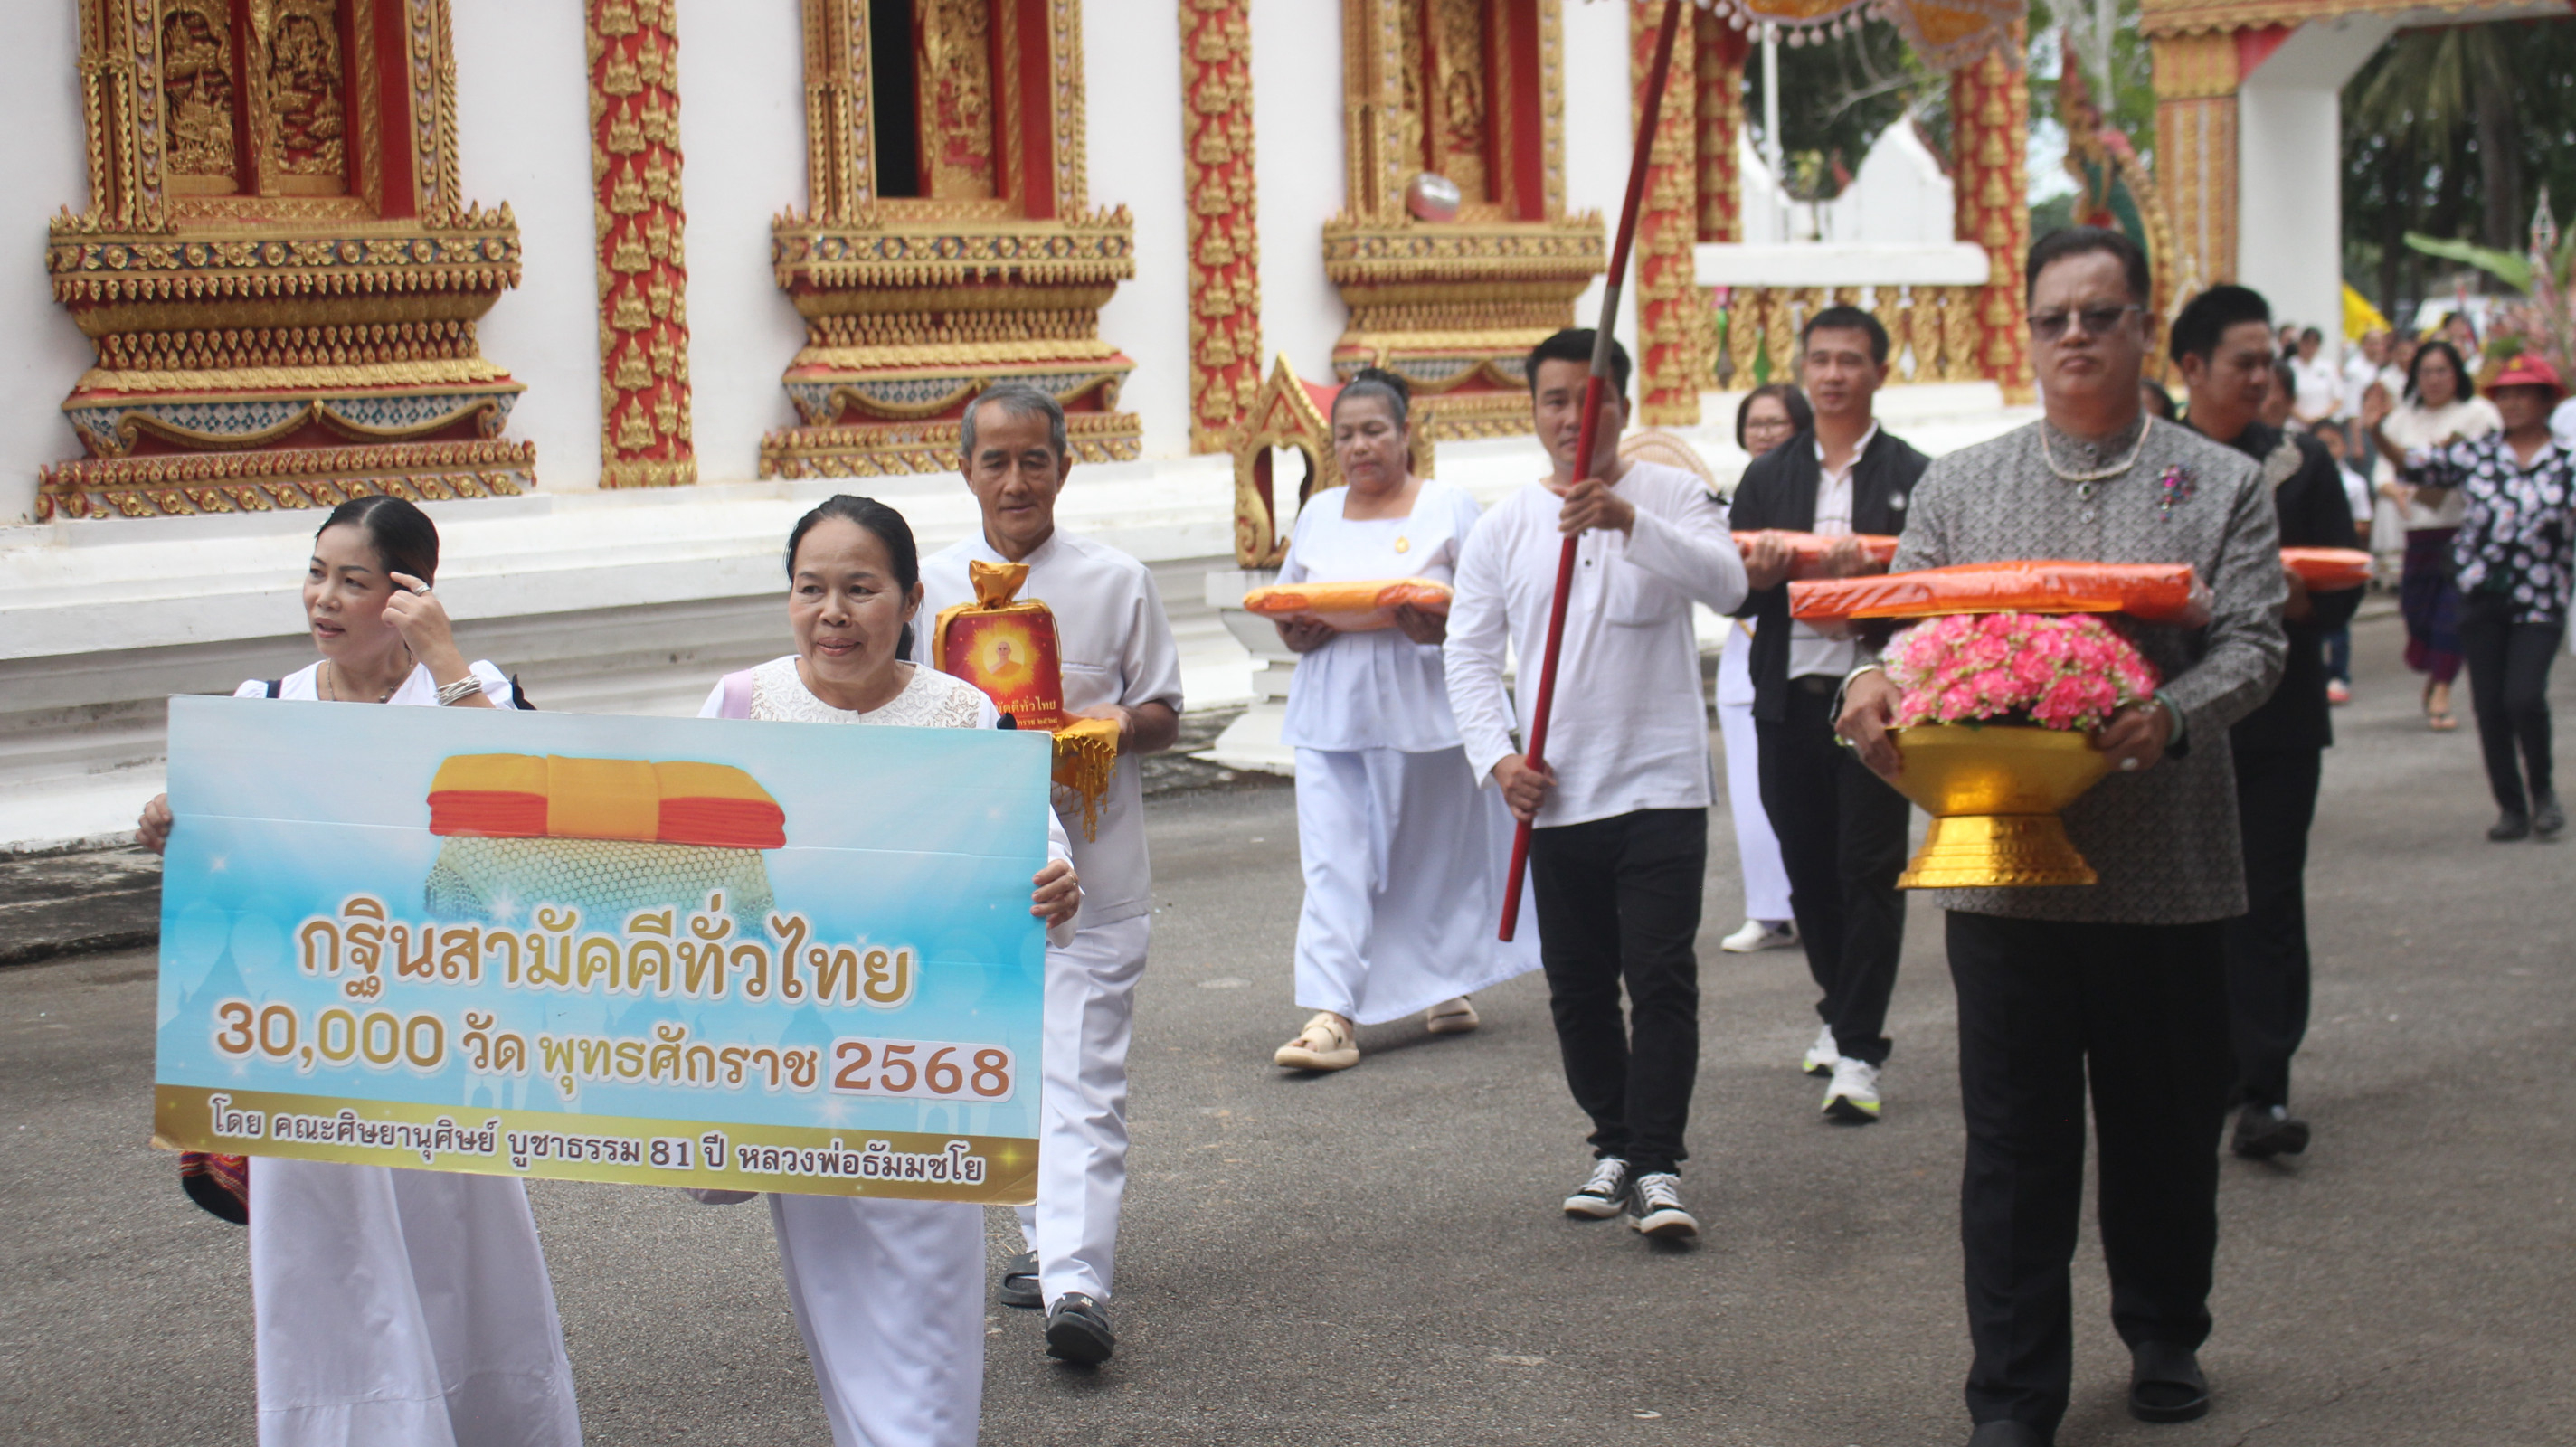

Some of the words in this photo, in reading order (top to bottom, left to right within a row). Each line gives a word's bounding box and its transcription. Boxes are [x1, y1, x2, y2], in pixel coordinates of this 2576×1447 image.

[301, 894, 908, 1003] กฐินสามัคคีทั่วไทย
[218, 1002, 444, 1068] 30,000
[463, 1012, 526, 1072] วัด
[539, 1025, 818, 1095] พุทธศักราช
[834, 1041, 1010, 1097] 2568
[213, 1097, 262, 1135] โดย
[275, 1112, 499, 1160] คณะศิษยานุศิษย์
[508, 1132, 640, 1168] บูชาธรรม
[650, 1140, 690, 1167] 81
[703, 1134, 725, 1168] ปี
[738, 1141, 983, 1182] หลวงพ่อธัมมชโย
